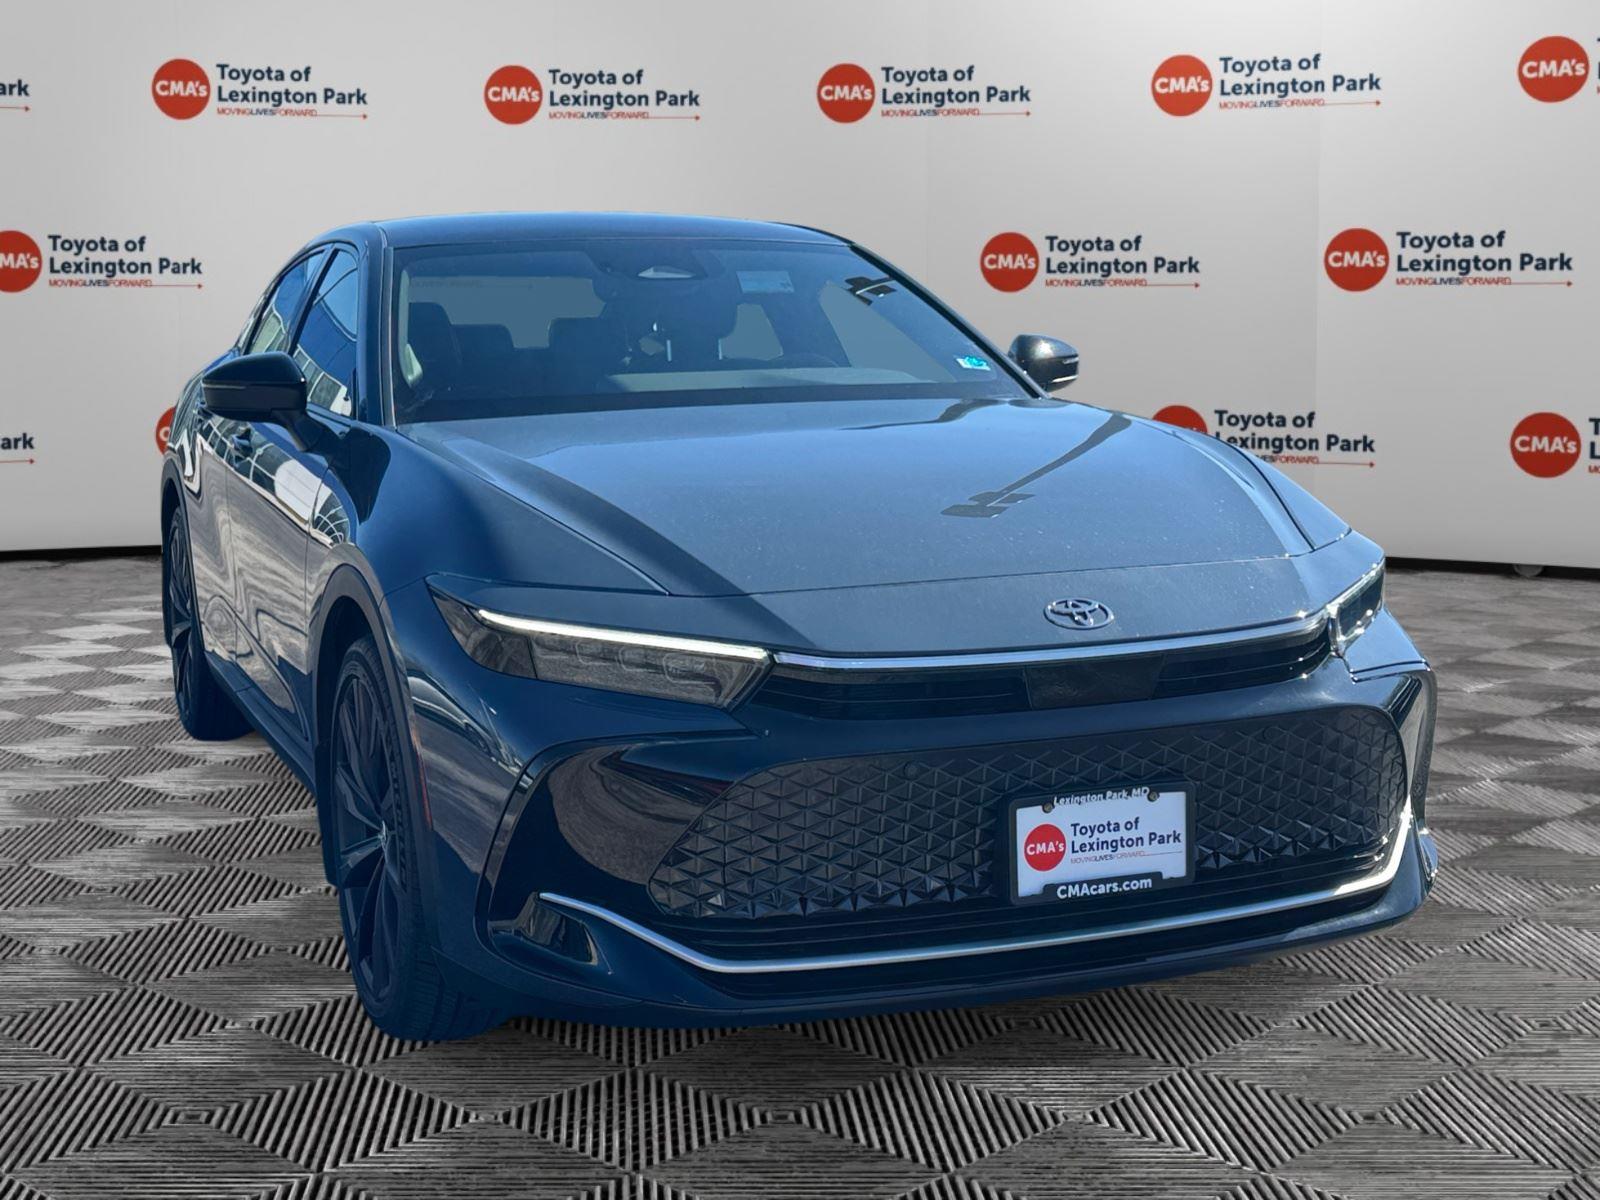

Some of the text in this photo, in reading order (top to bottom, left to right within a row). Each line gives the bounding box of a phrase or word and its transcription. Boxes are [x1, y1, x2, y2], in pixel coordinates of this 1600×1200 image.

[216, 64, 312, 84] Toyota of
[881, 65, 975, 87] Toyota of
[1219, 53, 1321, 78] Toyota of
[1521, 58, 1586, 79] CMA's
[0, 78, 30, 97] ark
[155, 80, 208, 98] CMA's
[548, 69, 644, 89] Toyota of
[1154, 74, 1210, 95] CMA's
[1219, 73, 1382, 99] Lexington Park
[217, 86, 368, 107] Lexington Park
[487, 86, 541, 103] CMA's
[549, 90, 700, 111] Lexington Park
[820, 84, 872, 102] CMA's
[881, 86, 1031, 108] Lexington Park
[47, 235, 147, 256] Toyota of
[1044, 235, 1143, 257] Toyota of
[1396, 230, 1506, 254] Toyota of
[0, 252, 39, 269] MA's
[49, 256, 203, 279] Lexington Park
[983, 253, 1036, 270] CMA's
[1045, 256, 1200, 278] Lexington Park
[1327, 250, 1386, 268] CMA's
[1396, 252, 1573, 277] Lexington Park
[1214, 409, 1316, 431] Toyota of
[0, 432, 35, 451] ark
[1326, 434, 1375, 453] Park
[1514, 435, 1577, 454] CMA's
[1053, 793, 1104, 806] Lexington
[1070, 816, 1140, 839] Toyota of
[1026, 840, 1065, 857] CMA's
[1071, 829, 1182, 855] Lexington Park
[1056, 877, 1153, 900] CMAcars.com
